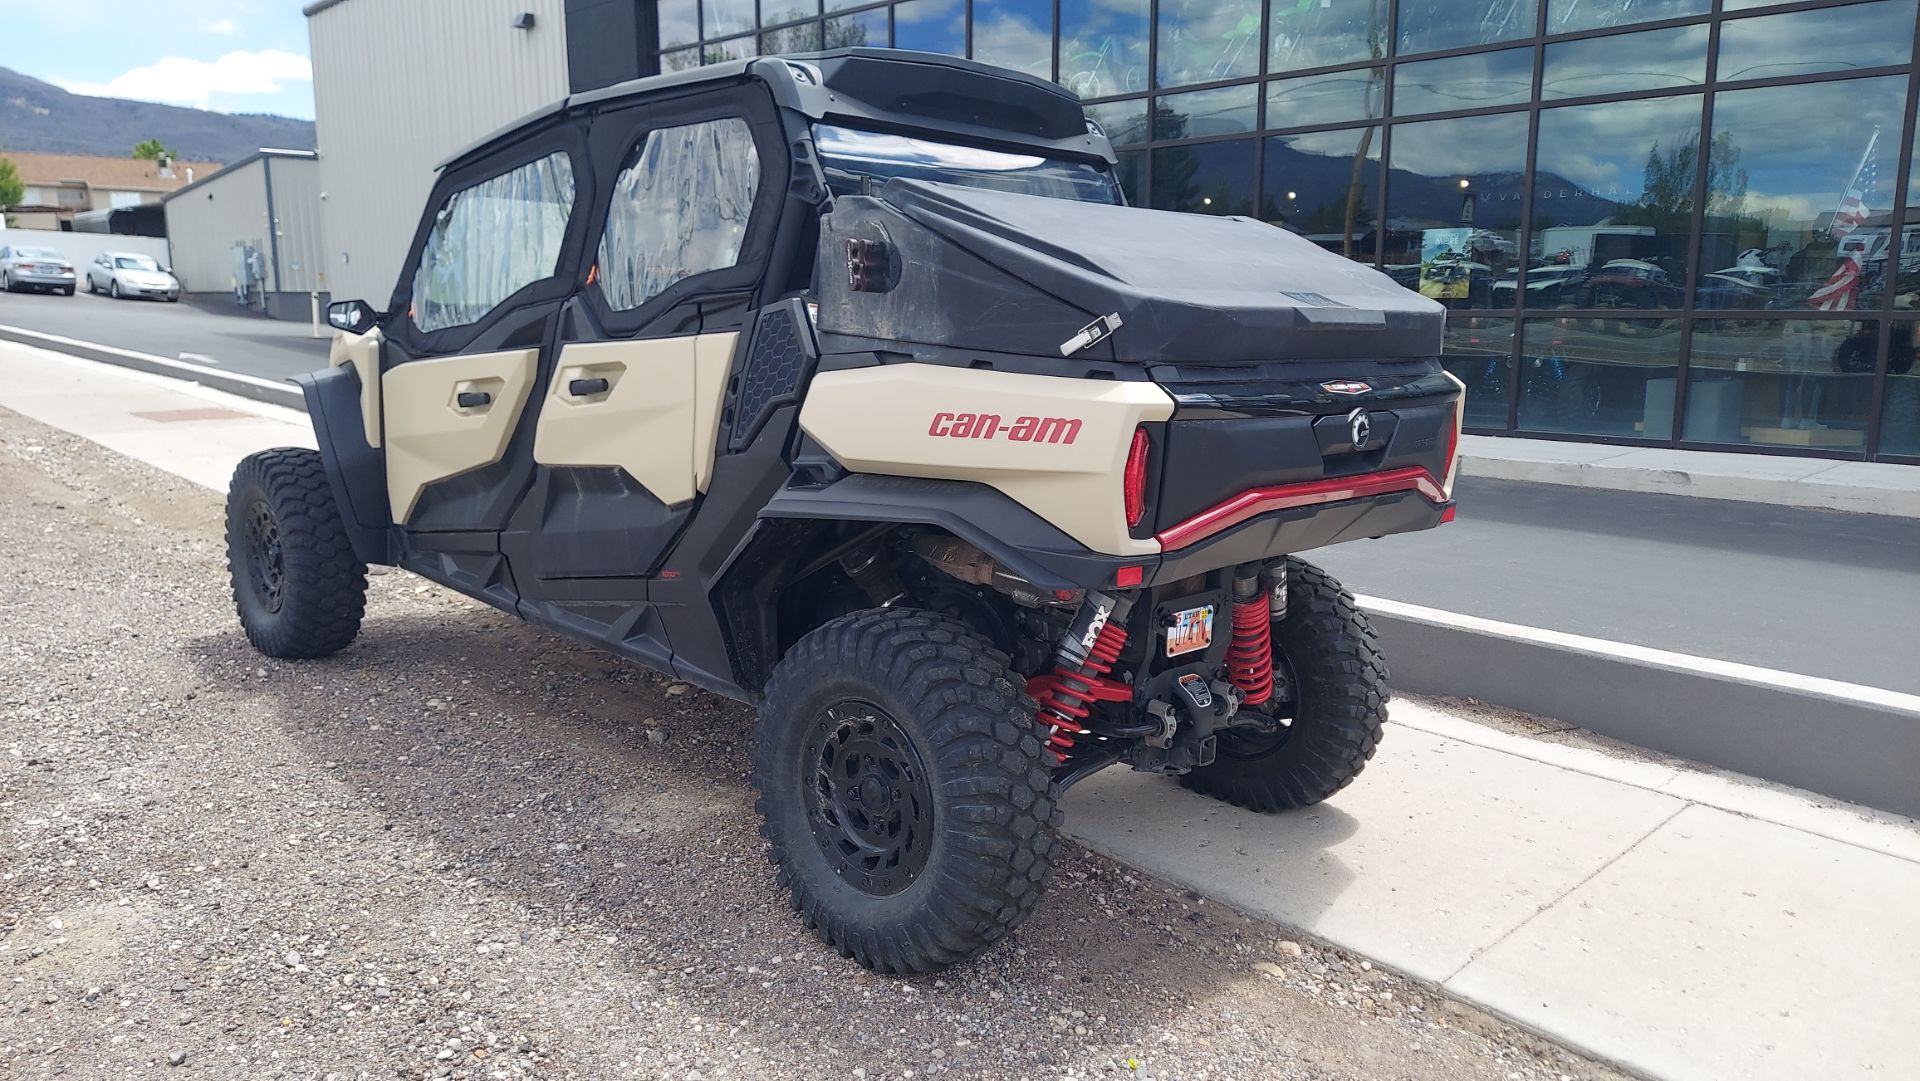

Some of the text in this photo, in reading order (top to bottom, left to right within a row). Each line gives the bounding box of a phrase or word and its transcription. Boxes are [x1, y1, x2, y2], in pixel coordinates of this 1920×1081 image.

[1499, 186, 1650, 201] VADERHALL
[928, 412, 1083, 445] can-am
[1081, 604, 1112, 650] FOX
